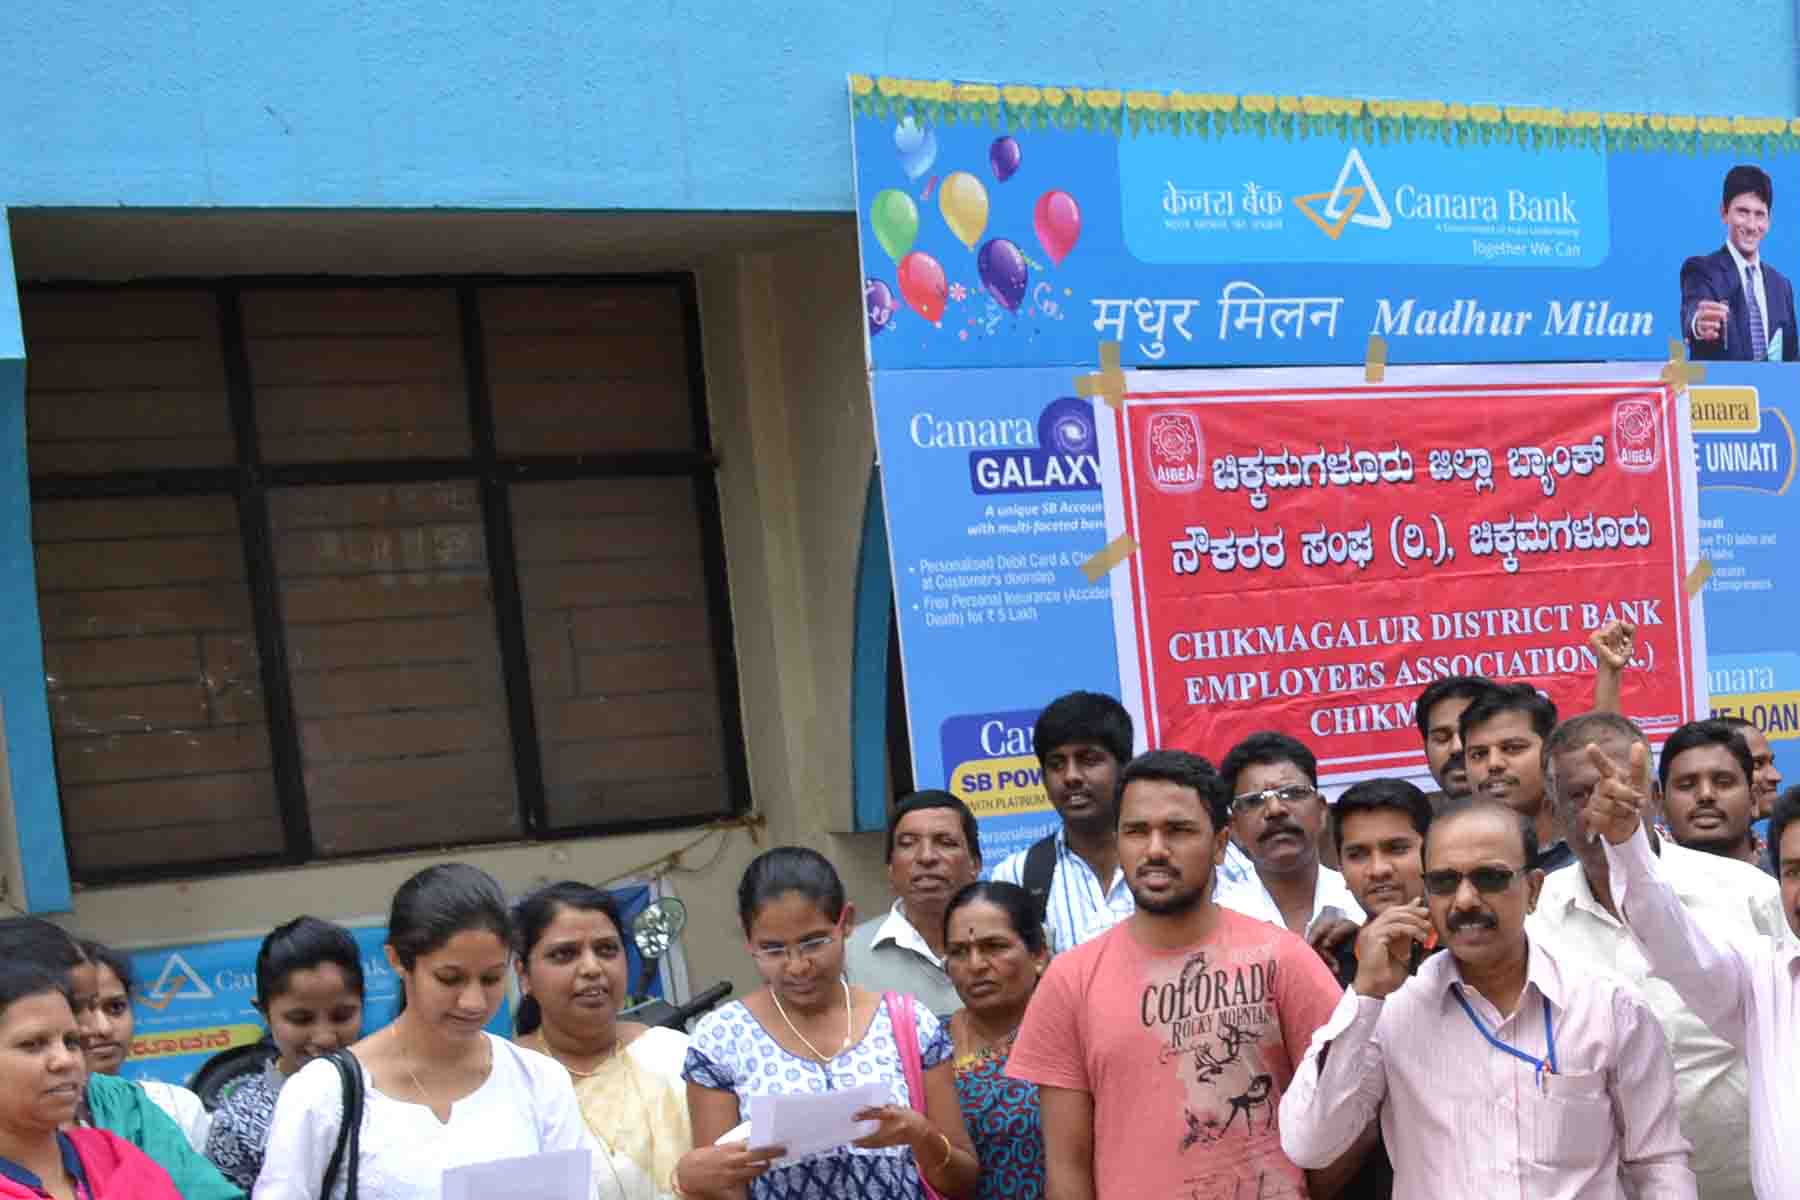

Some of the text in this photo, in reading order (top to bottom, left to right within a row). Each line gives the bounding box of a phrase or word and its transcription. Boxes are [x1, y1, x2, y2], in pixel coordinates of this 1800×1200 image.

[1395, 183, 1578, 224] Canara Bank
[1555, 240, 1582, 258] Can
[1092, 281, 1345, 359] मधुर मिलन
[1369, 299, 1653, 337] Madhur Milan
[910, 412, 1034, 449] Canara
[1691, 402, 1751, 422] anara
[1212, 434, 1606, 510] ಚಿಕ್ಕಮಗಳೂರು ಜಿಲ್ಲಾ ಬ್ಯಾಂಕ್
[1705, 442, 1778, 473] UNNATI
[1171, 523, 1286, 574] ನೌಕರರ
[1301, 520, 1374, 570] ಸಂಘ
[1469, 505, 1651, 573] ಚಿಕ್ಕಮಗಳೂರು
[1168, 598, 1664, 663] CHIKMAGALUR DISTRICT BANK
[1184, 661, 1386, 706] EMPLOYEES
[1397, 643, 1600, 687] ASSOCIATION
[961, 772, 993, 793] SB
[1142, 959, 1278, 1029] COLORADO
[1171, 1014, 1215, 1049] ROCKY
